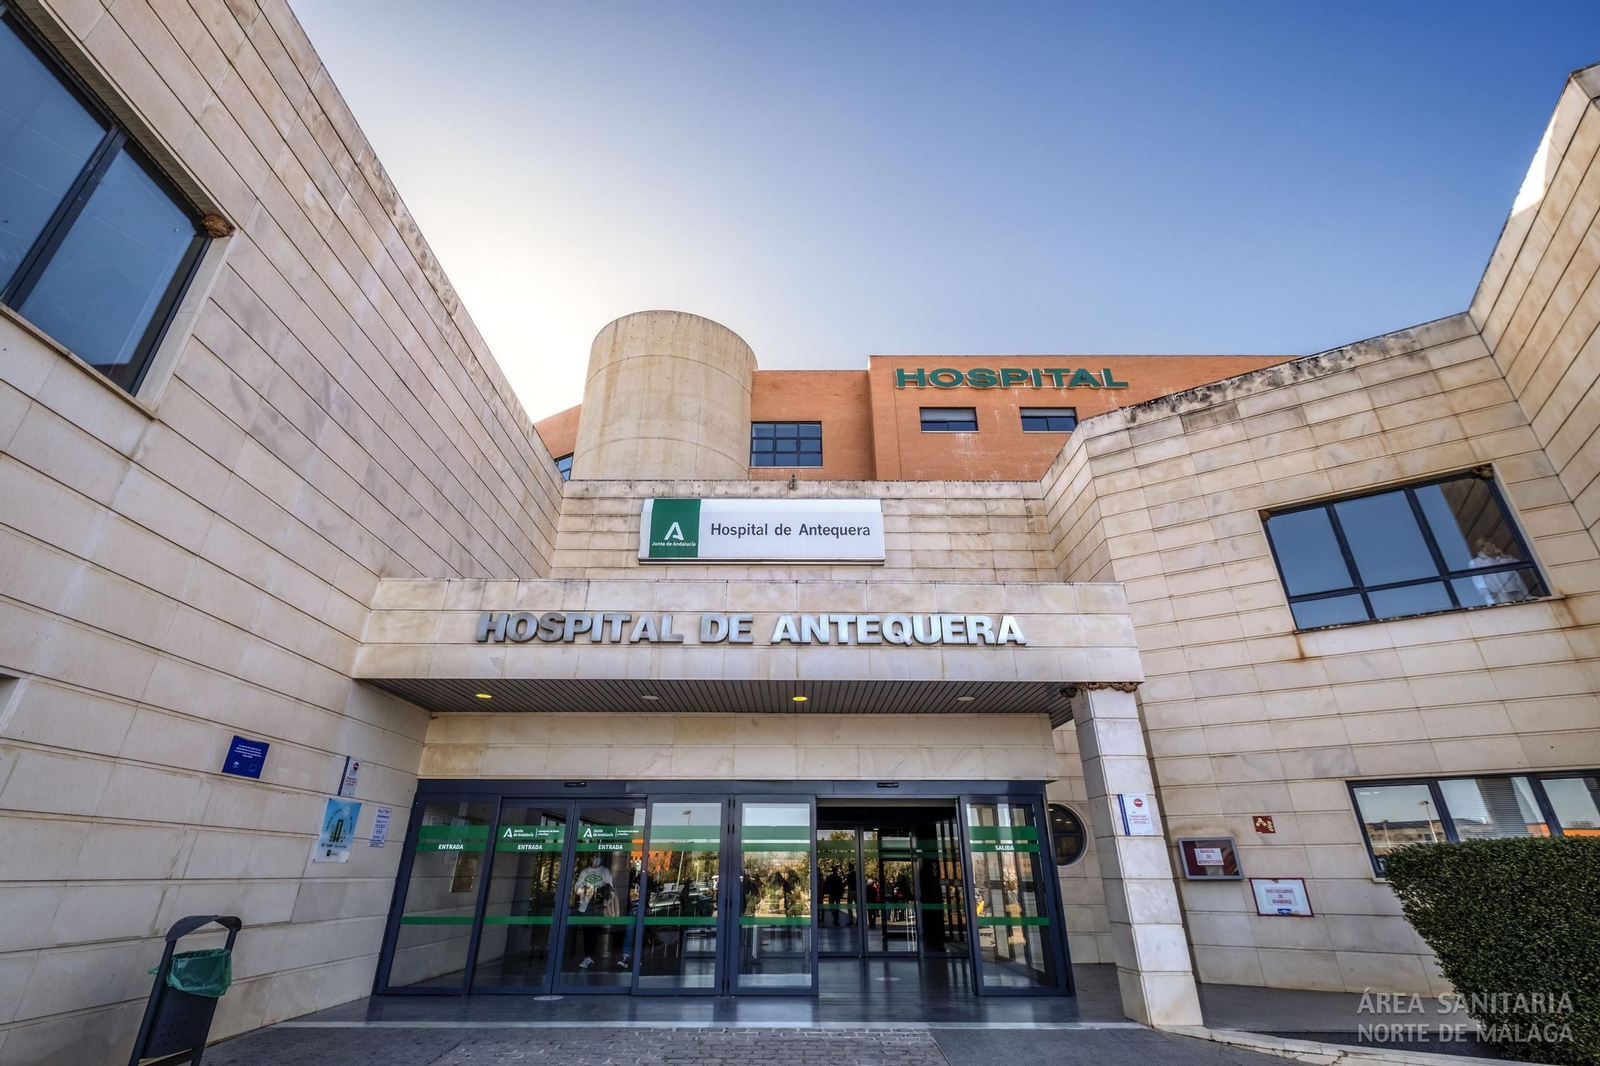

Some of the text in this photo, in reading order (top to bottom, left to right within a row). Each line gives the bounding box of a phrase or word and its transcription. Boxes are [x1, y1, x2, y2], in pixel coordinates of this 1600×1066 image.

[896, 368, 1128, 389] HOSPITAL
[710, 523, 870, 538] Hospital de Antequera
[476, 612, 1027, 647] HOSPITAL DE ANTEQUERA
